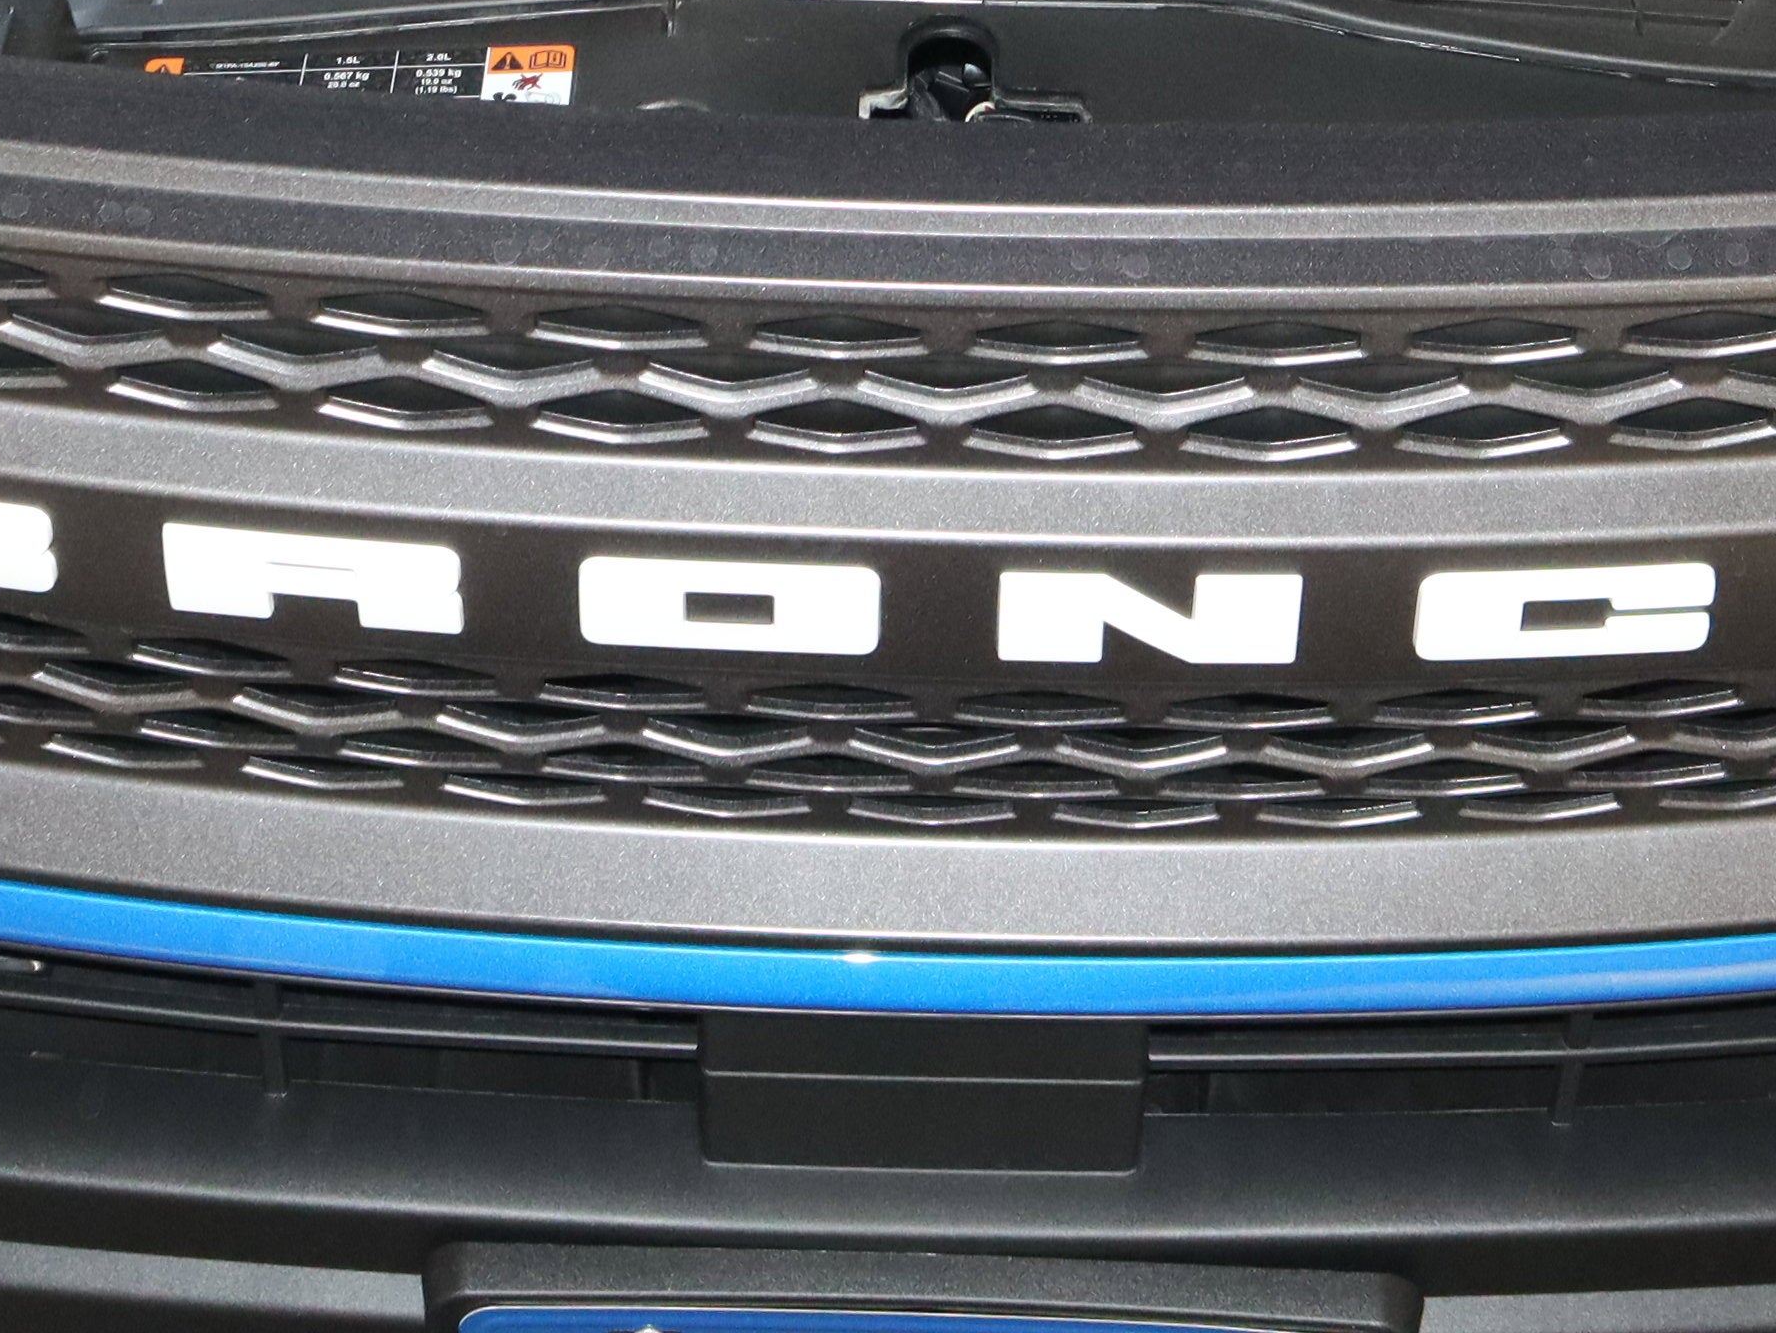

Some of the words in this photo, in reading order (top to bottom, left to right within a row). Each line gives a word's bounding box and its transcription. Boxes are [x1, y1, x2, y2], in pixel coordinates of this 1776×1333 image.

[426, 52, 452, 61] 2.0L
[355, 71, 370, 81] kg
[447, 68, 462, 78] kg
